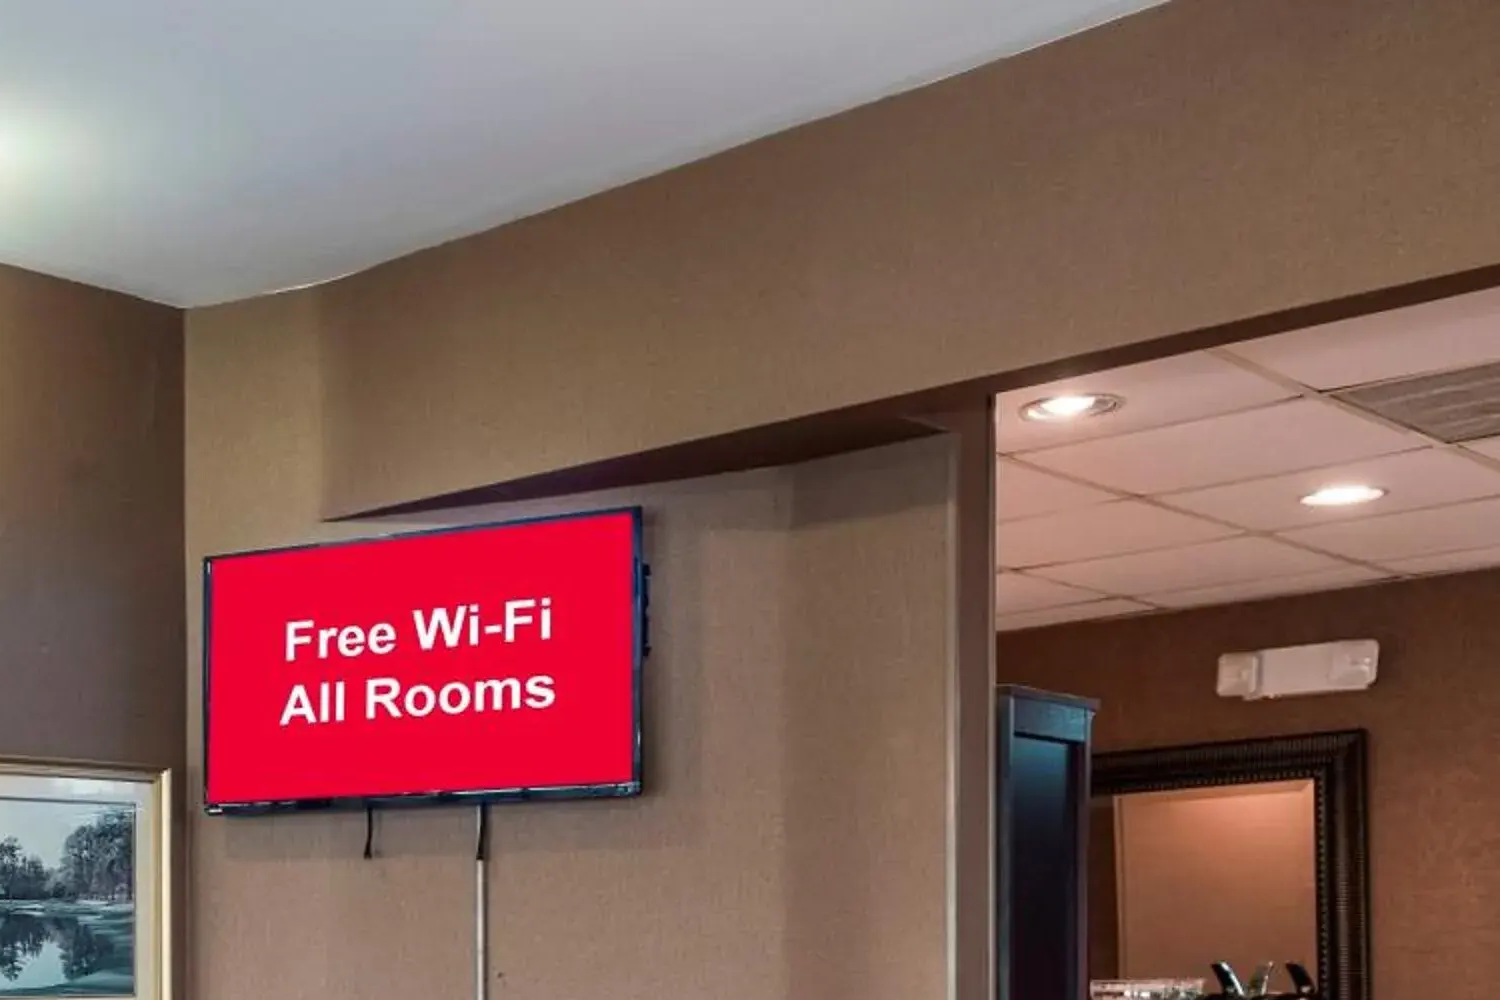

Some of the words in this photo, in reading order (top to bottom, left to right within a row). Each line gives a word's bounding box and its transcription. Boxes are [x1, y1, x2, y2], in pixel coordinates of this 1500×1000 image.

[285, 619, 397, 662] Free
[413, 597, 551, 650] Wi-Fi
[279, 681, 345, 726] All
[365, 675, 556, 720] Rooms
